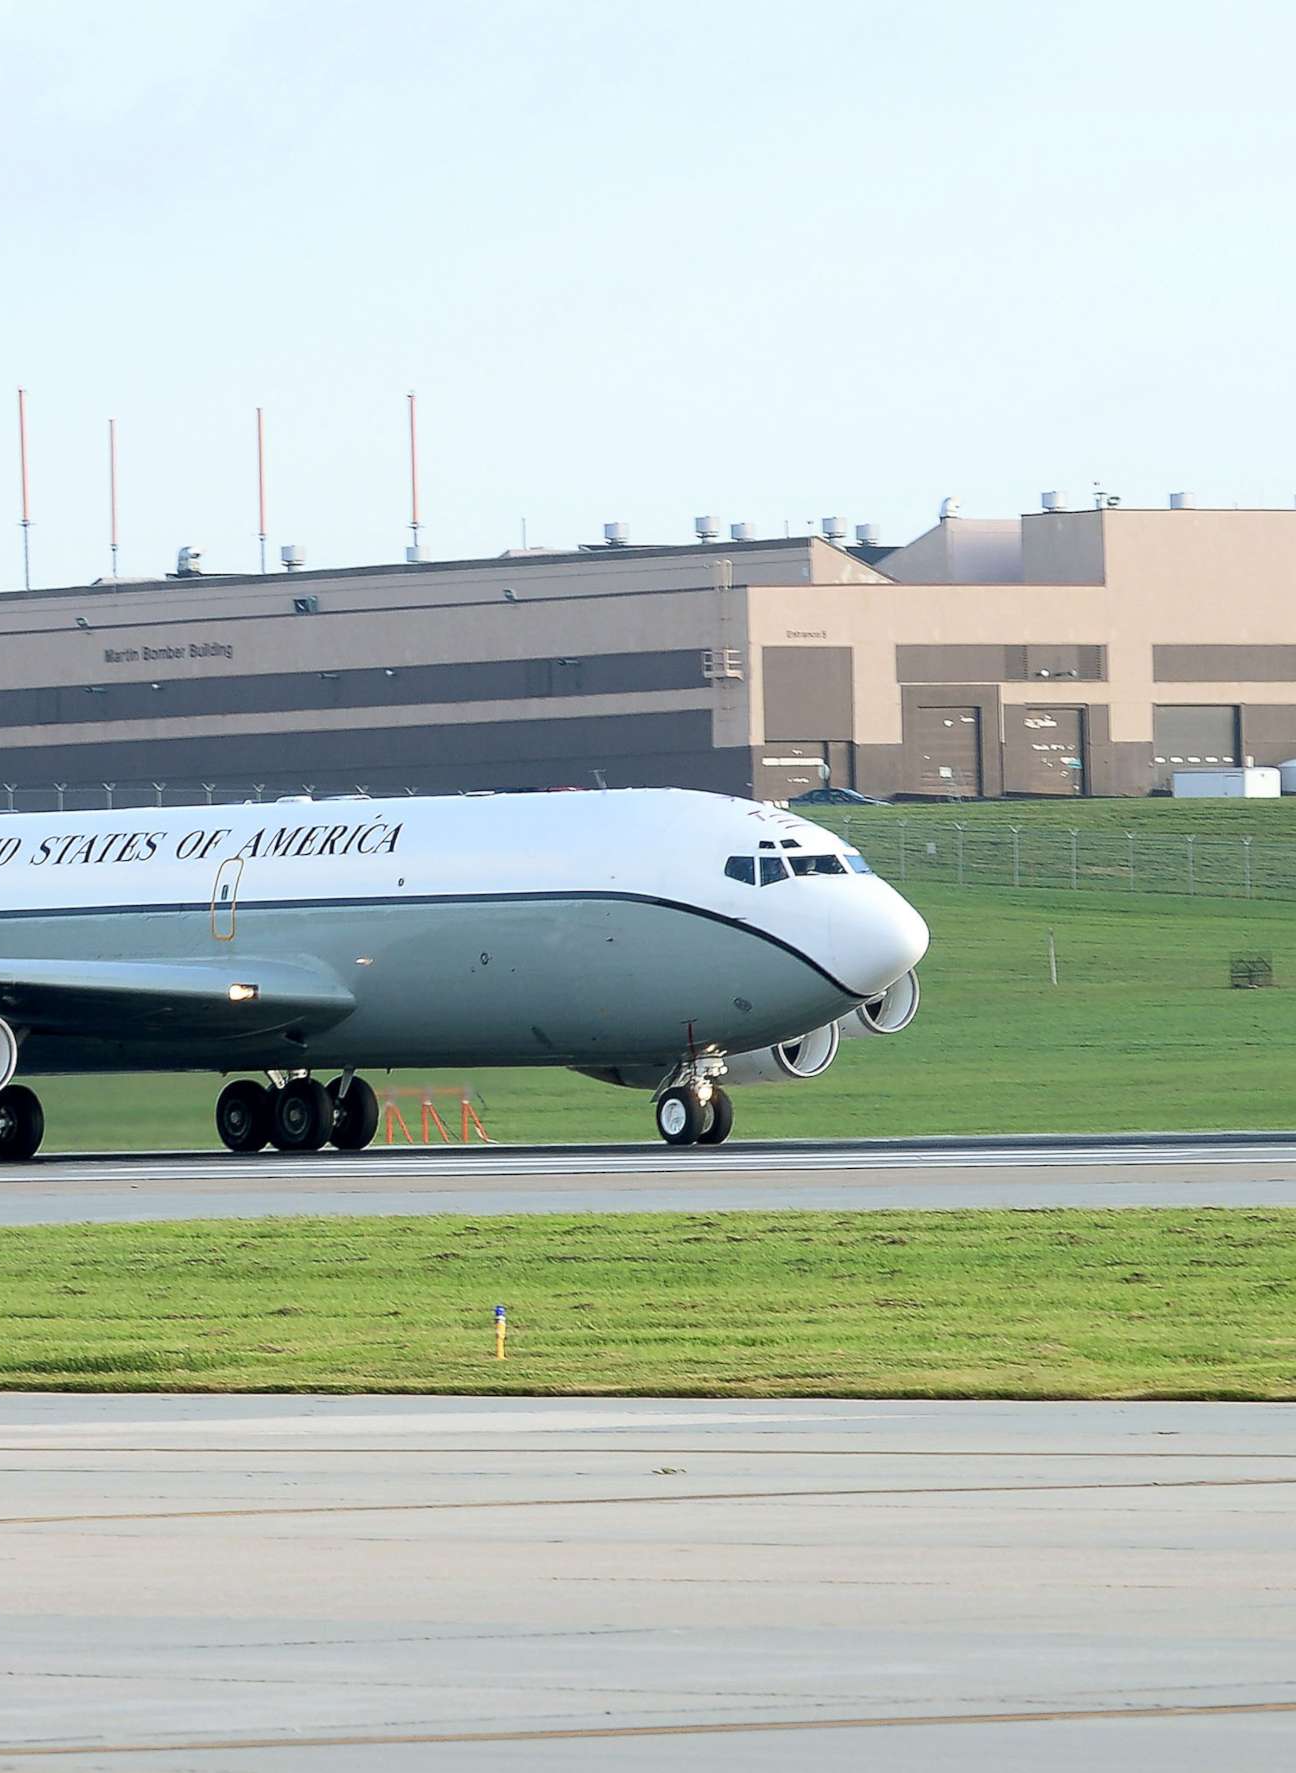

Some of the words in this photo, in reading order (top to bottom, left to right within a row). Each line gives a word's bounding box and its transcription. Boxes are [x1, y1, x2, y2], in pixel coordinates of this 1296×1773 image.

[104, 648, 139, 662] Martin
[142, 645, 186, 660] Bomber
[188, 642, 233, 659] Building
[29, 831, 168, 866] STATES
[175, 828, 233, 860] OF
[236, 822, 404, 859] AMERICA
